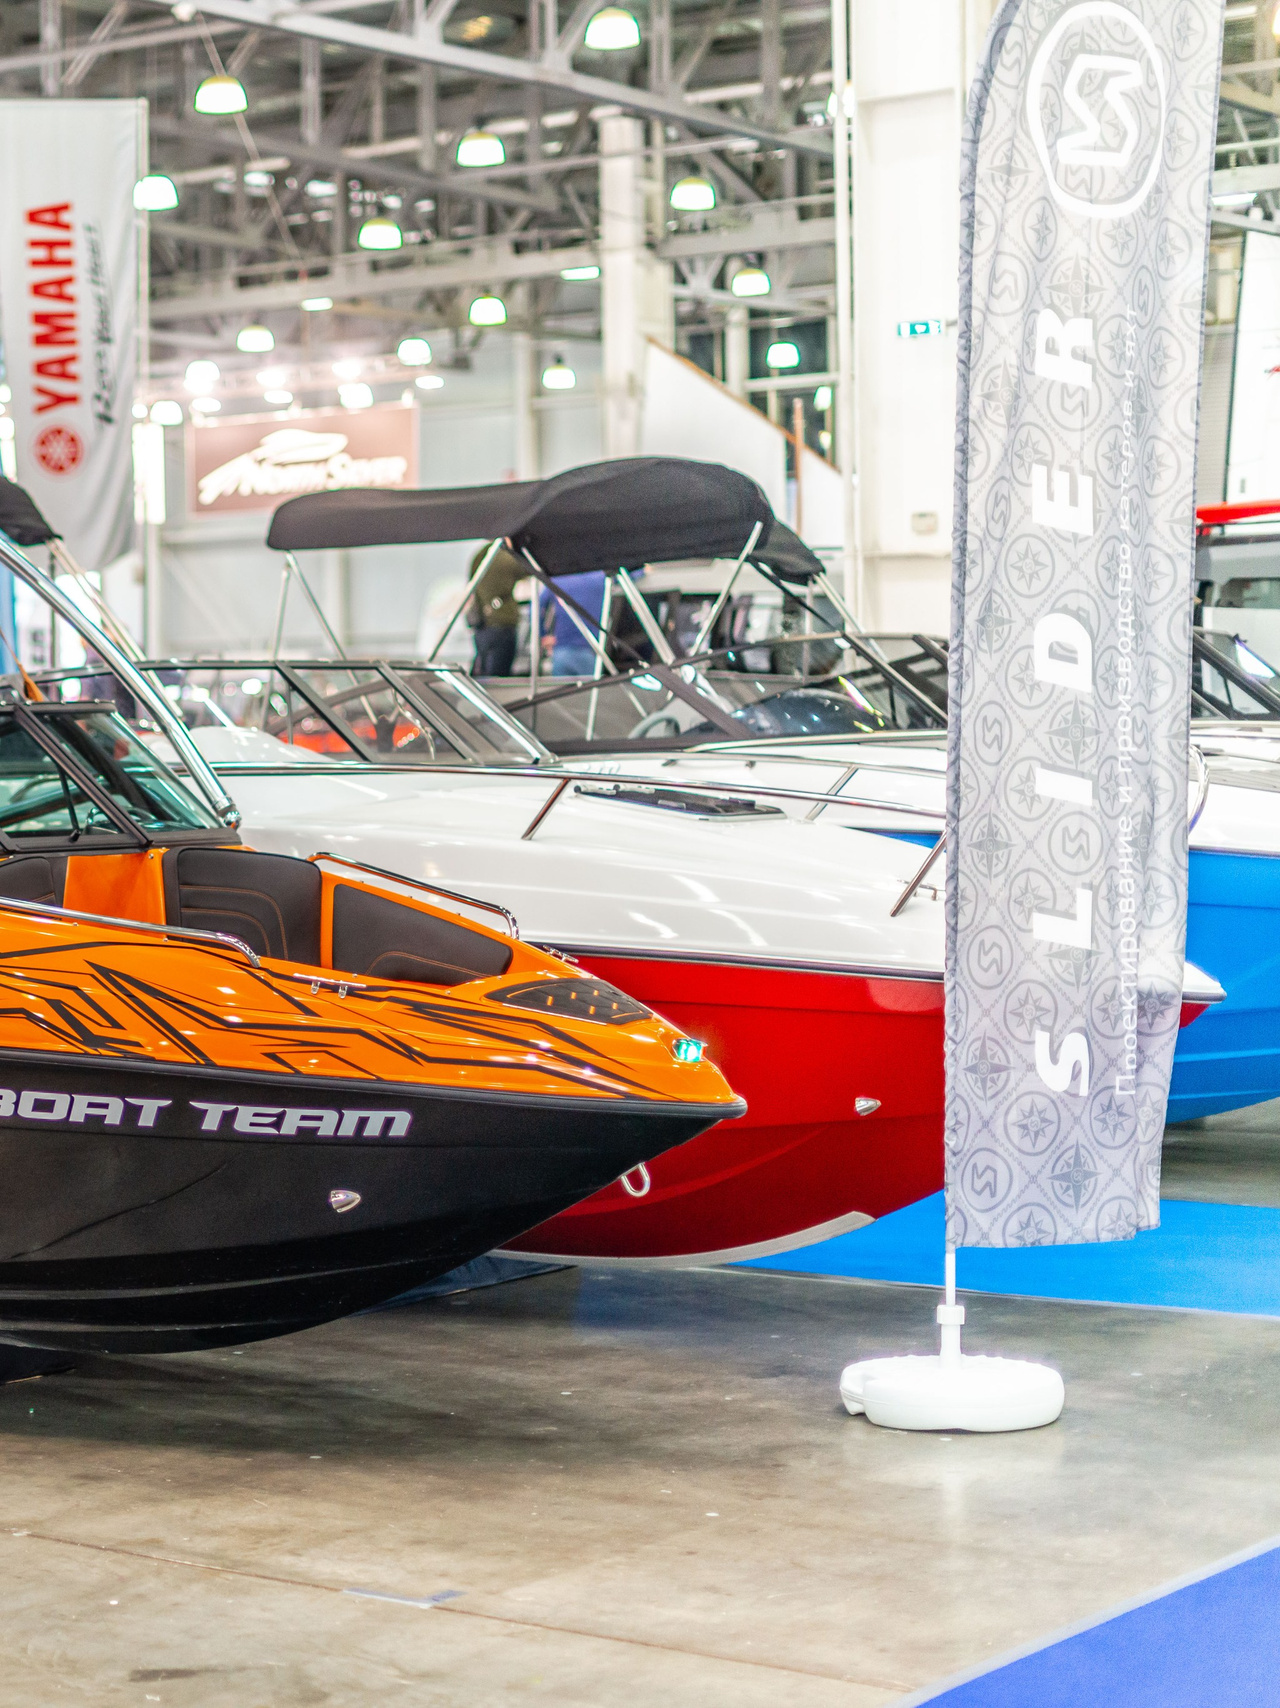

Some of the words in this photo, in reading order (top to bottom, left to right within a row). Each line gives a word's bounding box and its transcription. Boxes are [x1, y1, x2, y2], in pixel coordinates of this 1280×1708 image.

[25, 200, 81, 415] YAMAHA
[1125, 303, 1138, 356] яхт
[1124, 369, 1135, 388] и
[1119, 401, 1136, 532] катеров
[1032, 307, 1094, 1097] SLIDER
[1117, 542, 1138, 773] производство
[1119, 785, 1133, 803] и
[1115, 814, 1141, 1096] Проектирование
[189, 1100, 413, 1137] TEAM
